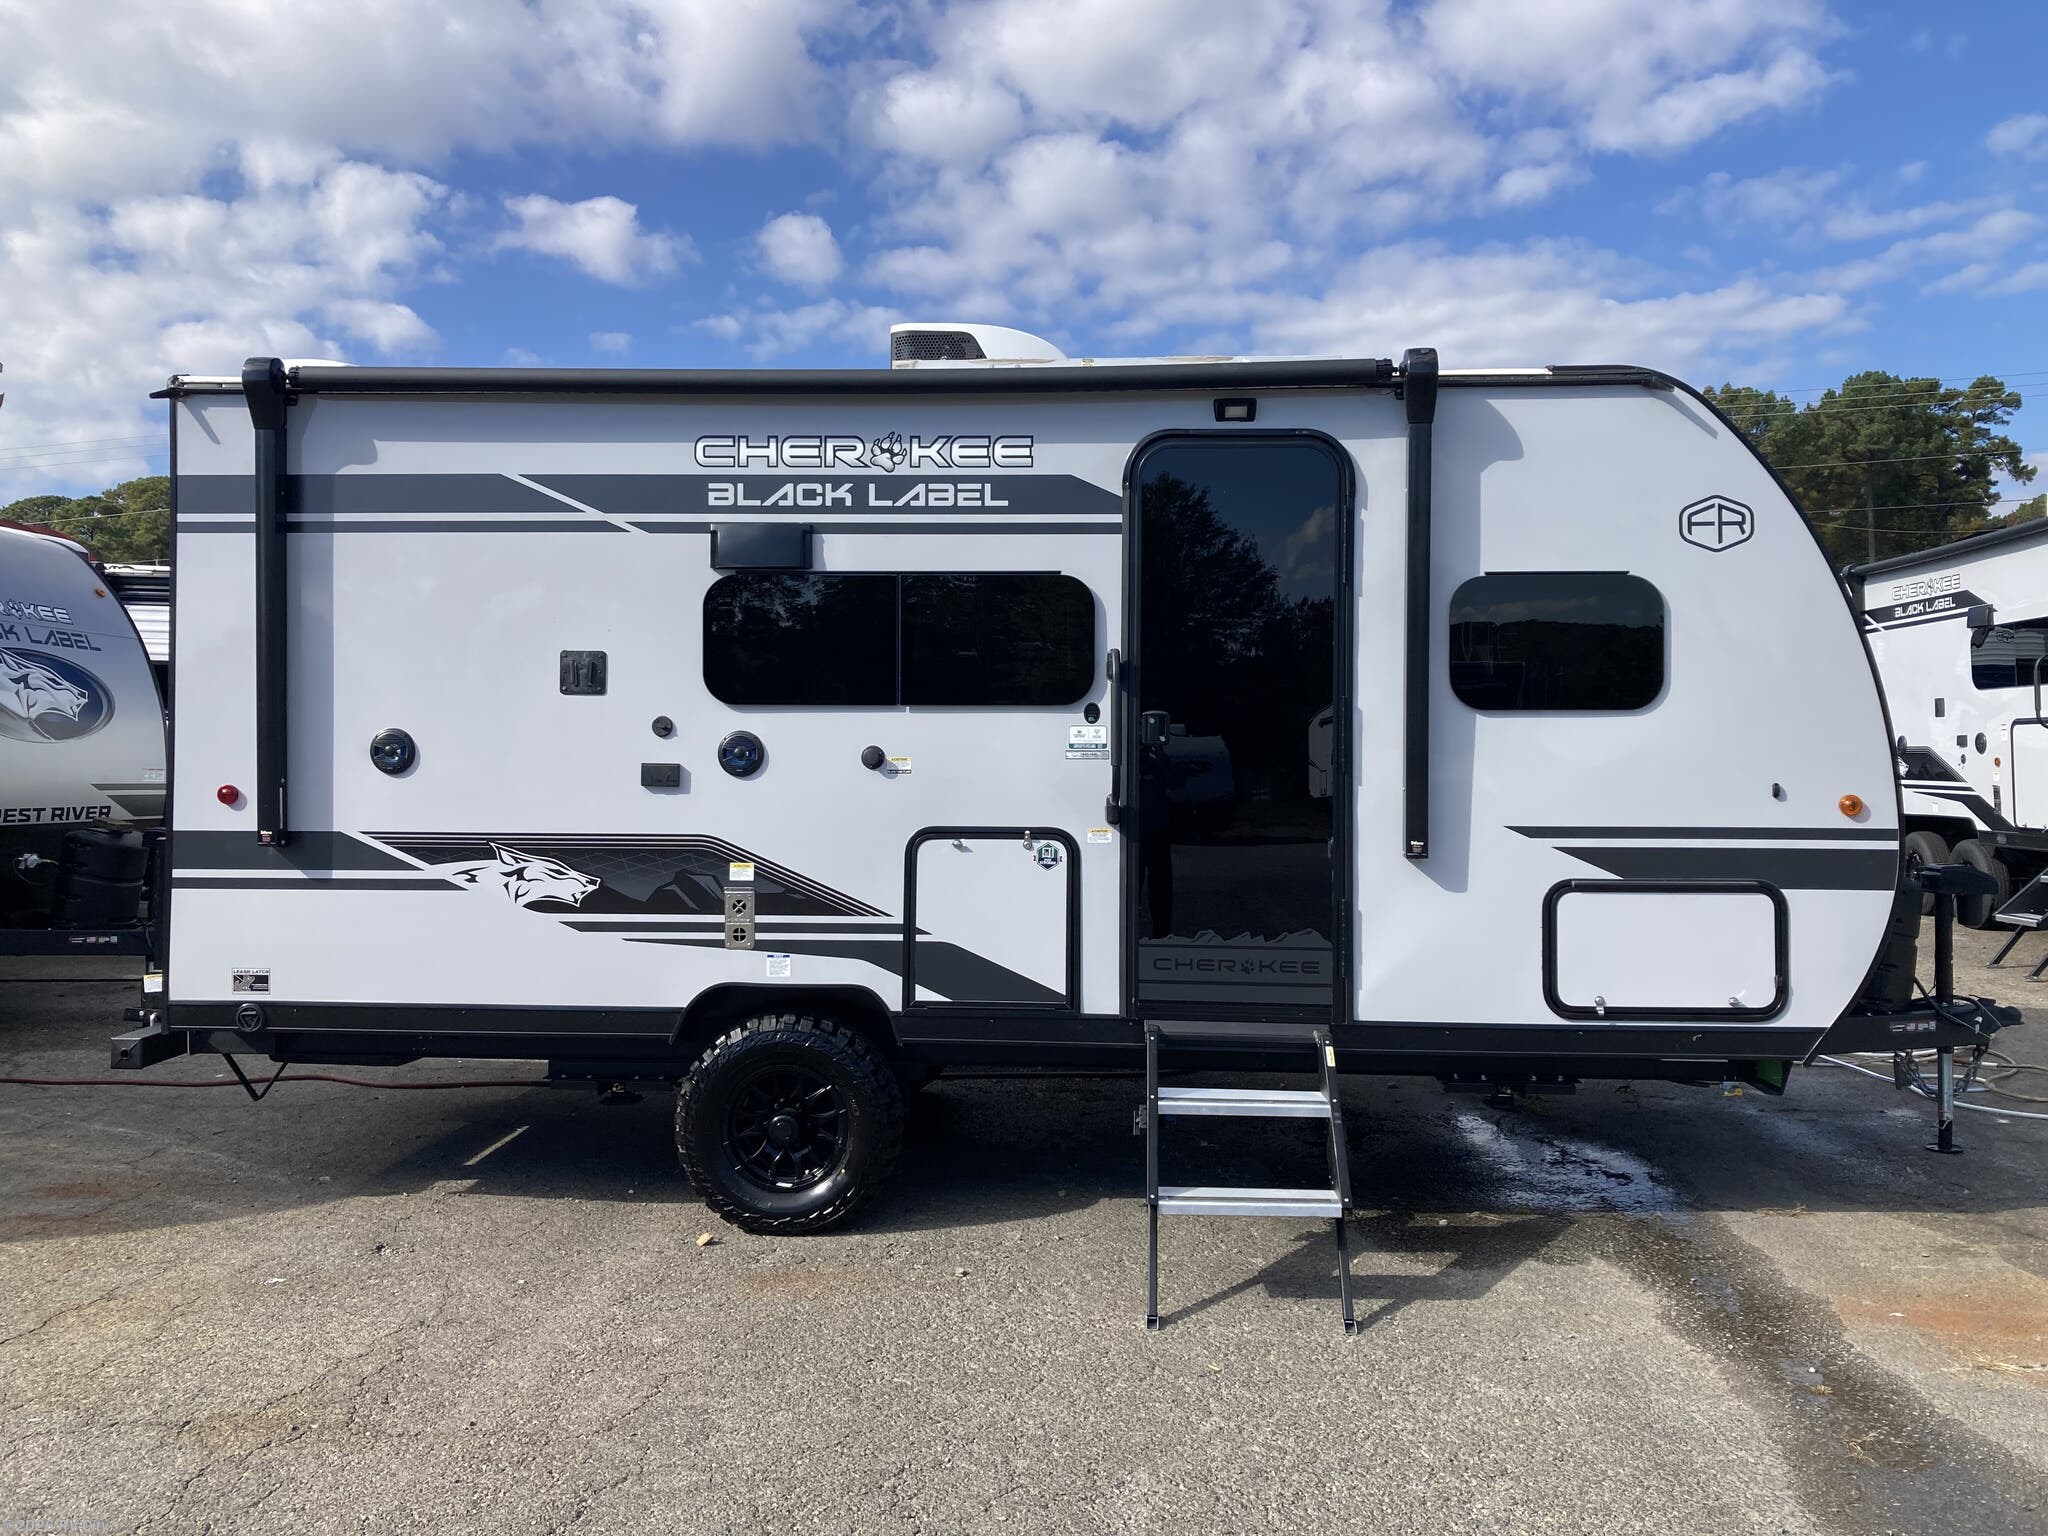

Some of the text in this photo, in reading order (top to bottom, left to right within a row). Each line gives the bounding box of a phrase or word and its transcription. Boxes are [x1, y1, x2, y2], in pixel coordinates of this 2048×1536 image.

[693, 432, 1034, 472] CHEROKEE
[707, 483, 1009, 507] BLACK LABEL
[1892, 574, 1961, 601] CHEROKEE
[1894, 596, 1957, 618] BLACK LABEL
[23, 626, 102, 651] LABEL
[50, 806, 111, 821] RIVER
[1153, 957, 1321, 975] CHEROKEE
